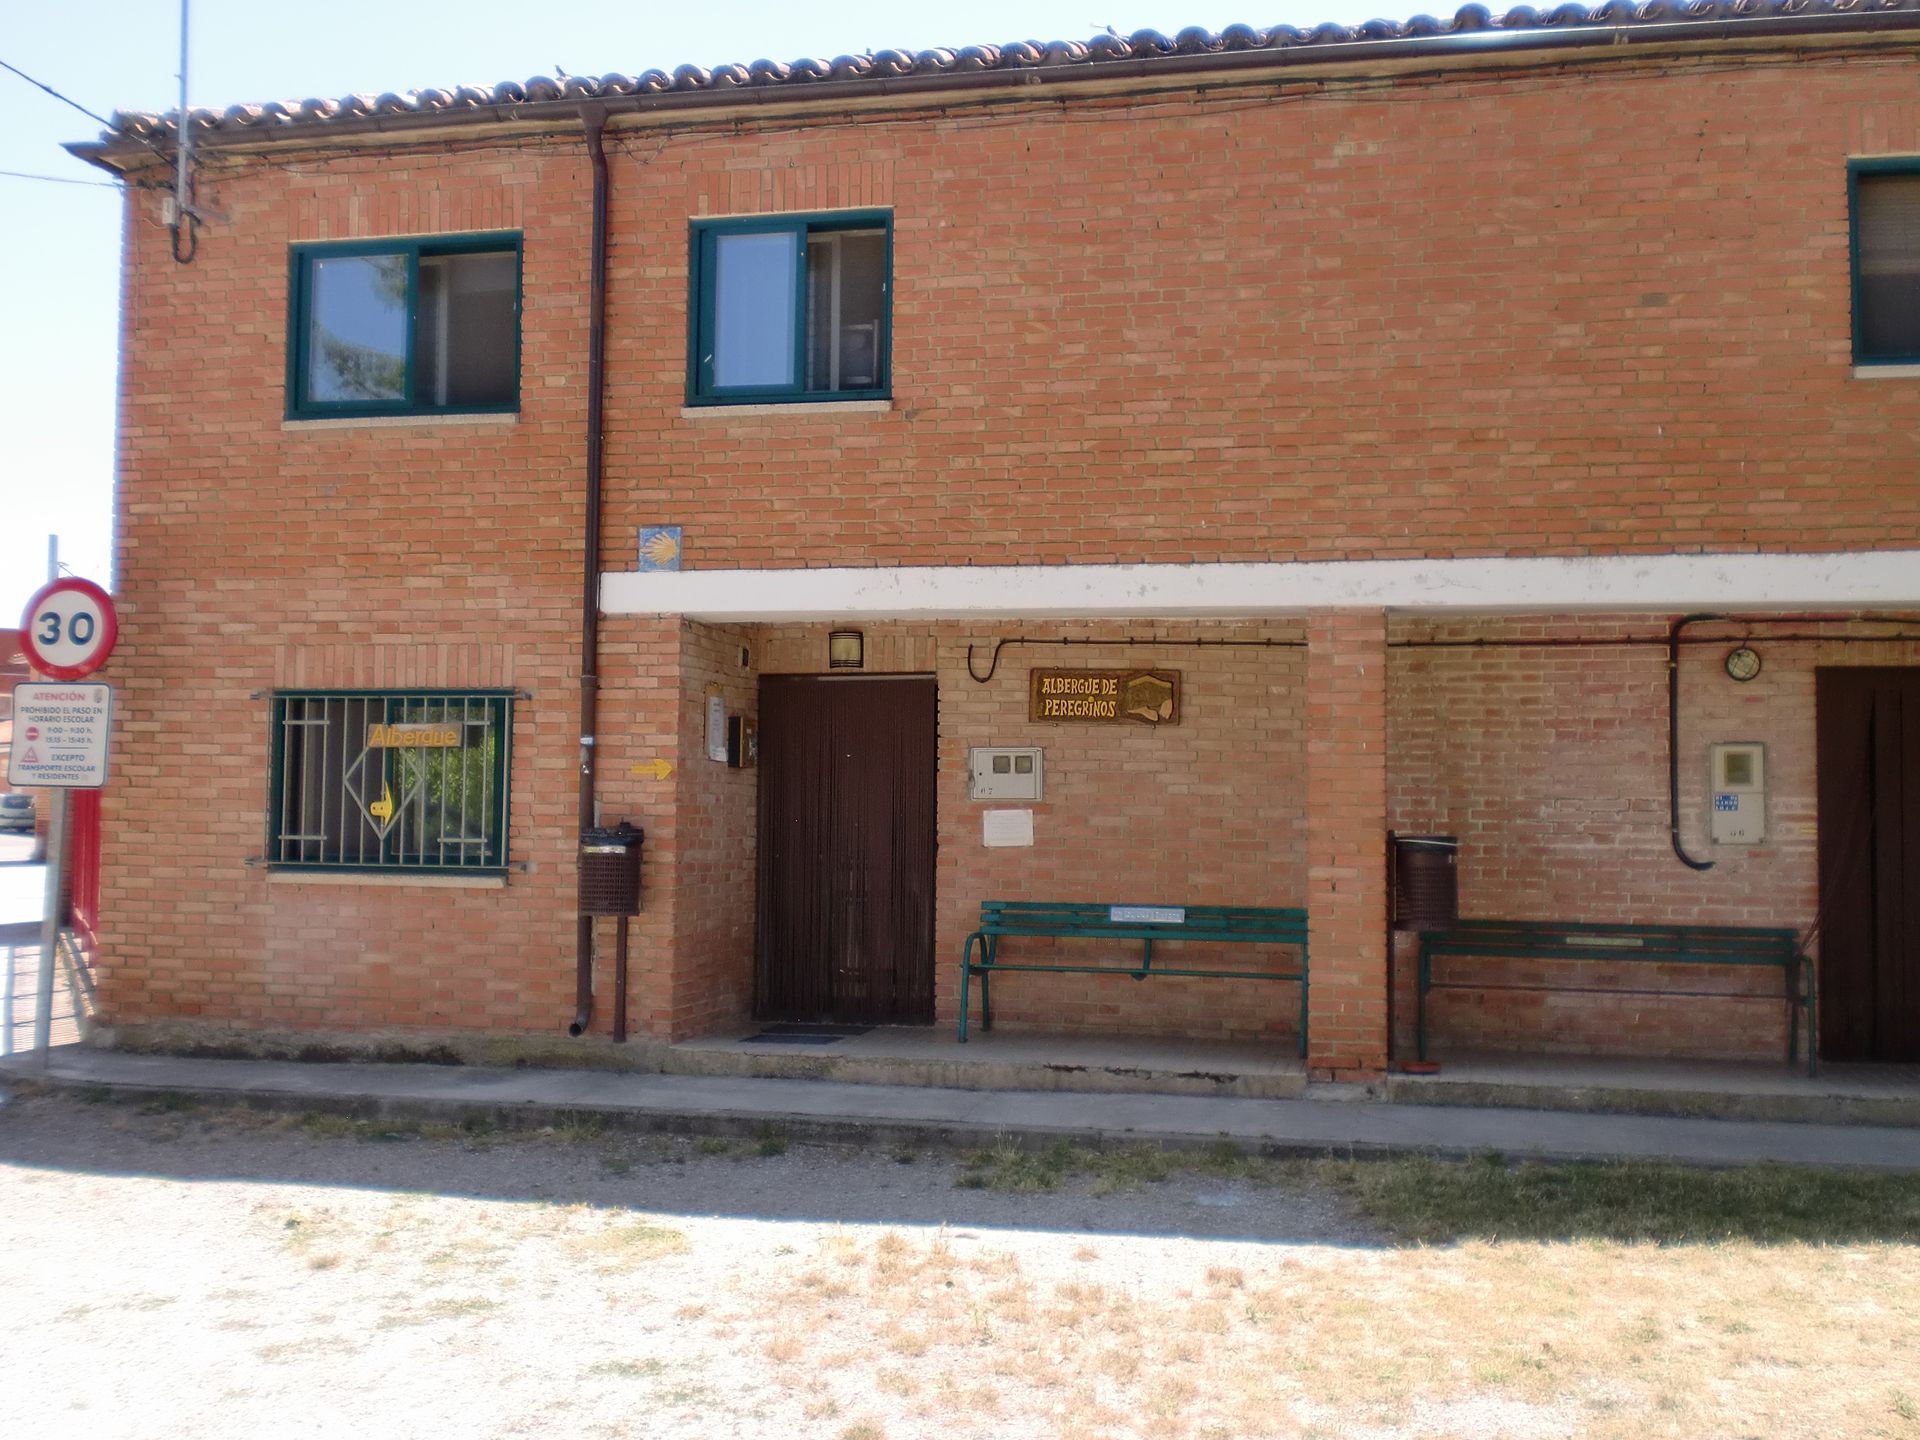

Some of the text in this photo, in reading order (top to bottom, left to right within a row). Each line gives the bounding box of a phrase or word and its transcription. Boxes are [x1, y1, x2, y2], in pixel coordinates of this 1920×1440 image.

[38, 611, 94, 646] 30
[1041, 677, 1118, 695] ALBERGUE DE
[33, 691, 86, 701] ATENCIÓN
[20, 706, 61, 714] PROHIBIDO
[92, 707, 103, 715] EN
[1044, 696, 1117, 718] PEREGRINOS
[28, 715, 61, 723] HORARIO
[369, 723, 457, 747] Albergue
